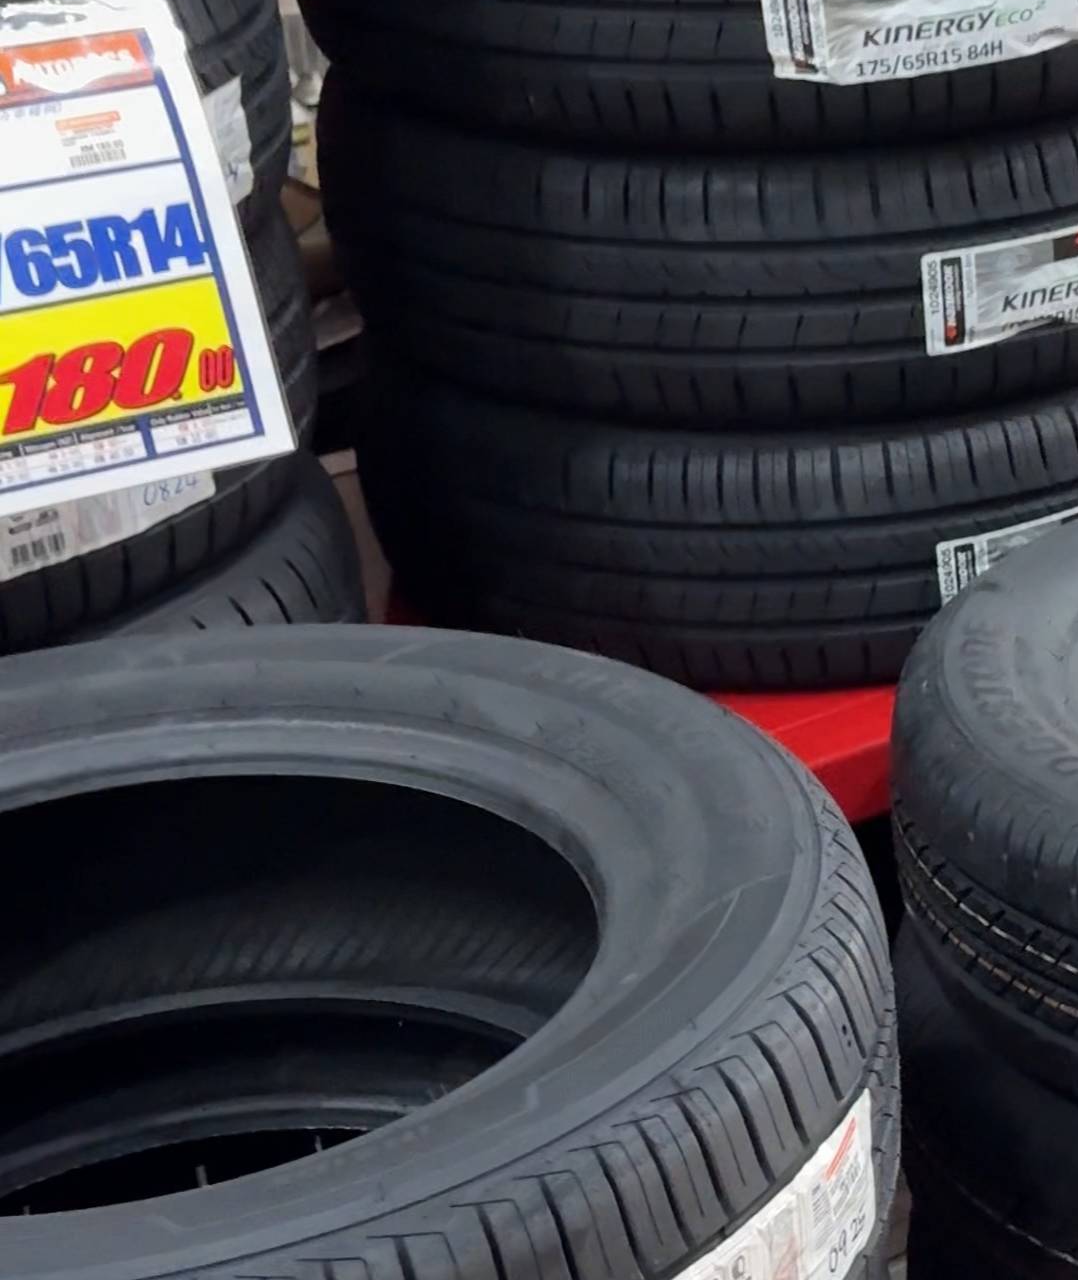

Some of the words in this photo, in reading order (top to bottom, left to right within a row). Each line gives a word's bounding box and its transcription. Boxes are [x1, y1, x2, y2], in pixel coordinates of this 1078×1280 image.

[863, 9, 995, 48] KINERGY
[856, 49, 962, 78] 175/65R15
[967, 39, 1003, 60] 84H
[928, 260, 940, 315] 1024905
[2, 326, 195, 437] 180
[200, 345, 235, 392] 00
